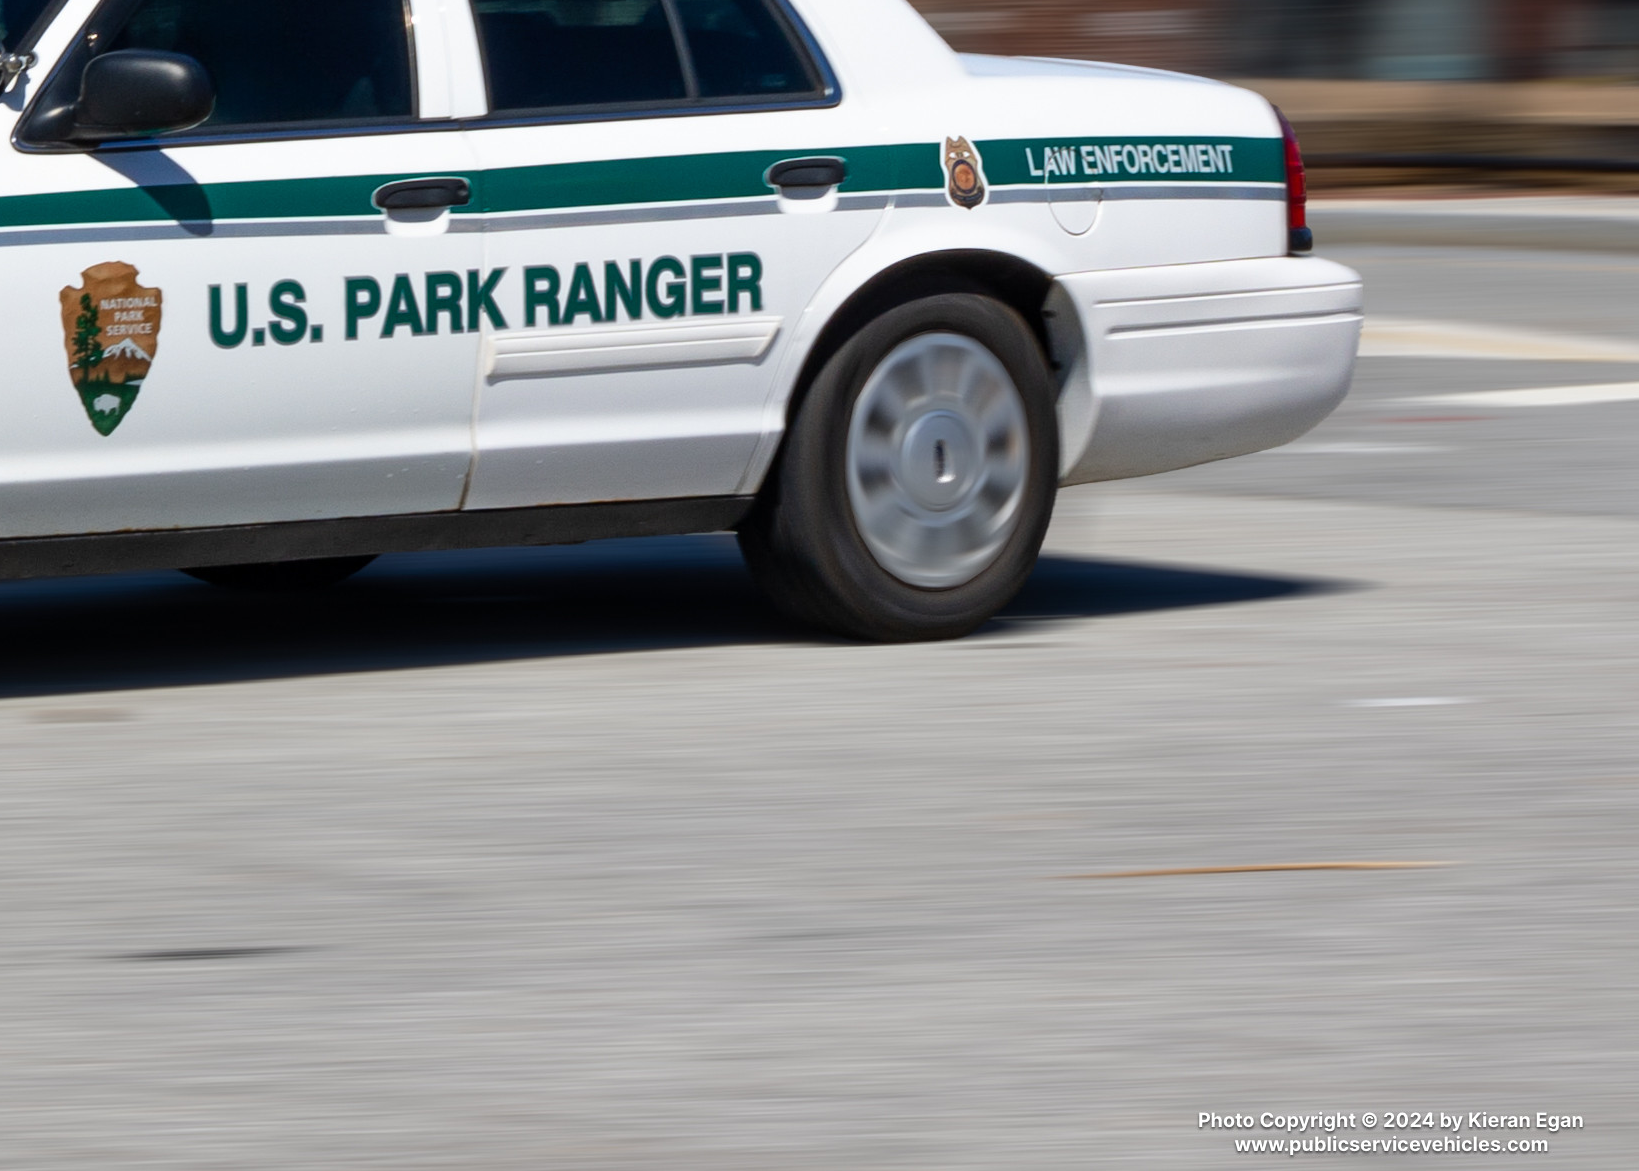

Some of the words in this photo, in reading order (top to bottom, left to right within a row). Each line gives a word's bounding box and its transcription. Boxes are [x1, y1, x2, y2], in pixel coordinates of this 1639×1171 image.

[1025, 146, 1076, 176] LAW
[1080, 144, 1234, 175] ENFORCEMENT
[100, 296, 158, 310] NATIONAL
[207, 279, 324, 349] U.S.
[343, 267, 508, 341] PARK
[523, 251, 764, 329] RANGER
[114, 310, 145, 323] PARK
[106, 323, 152, 336] SERVICE
